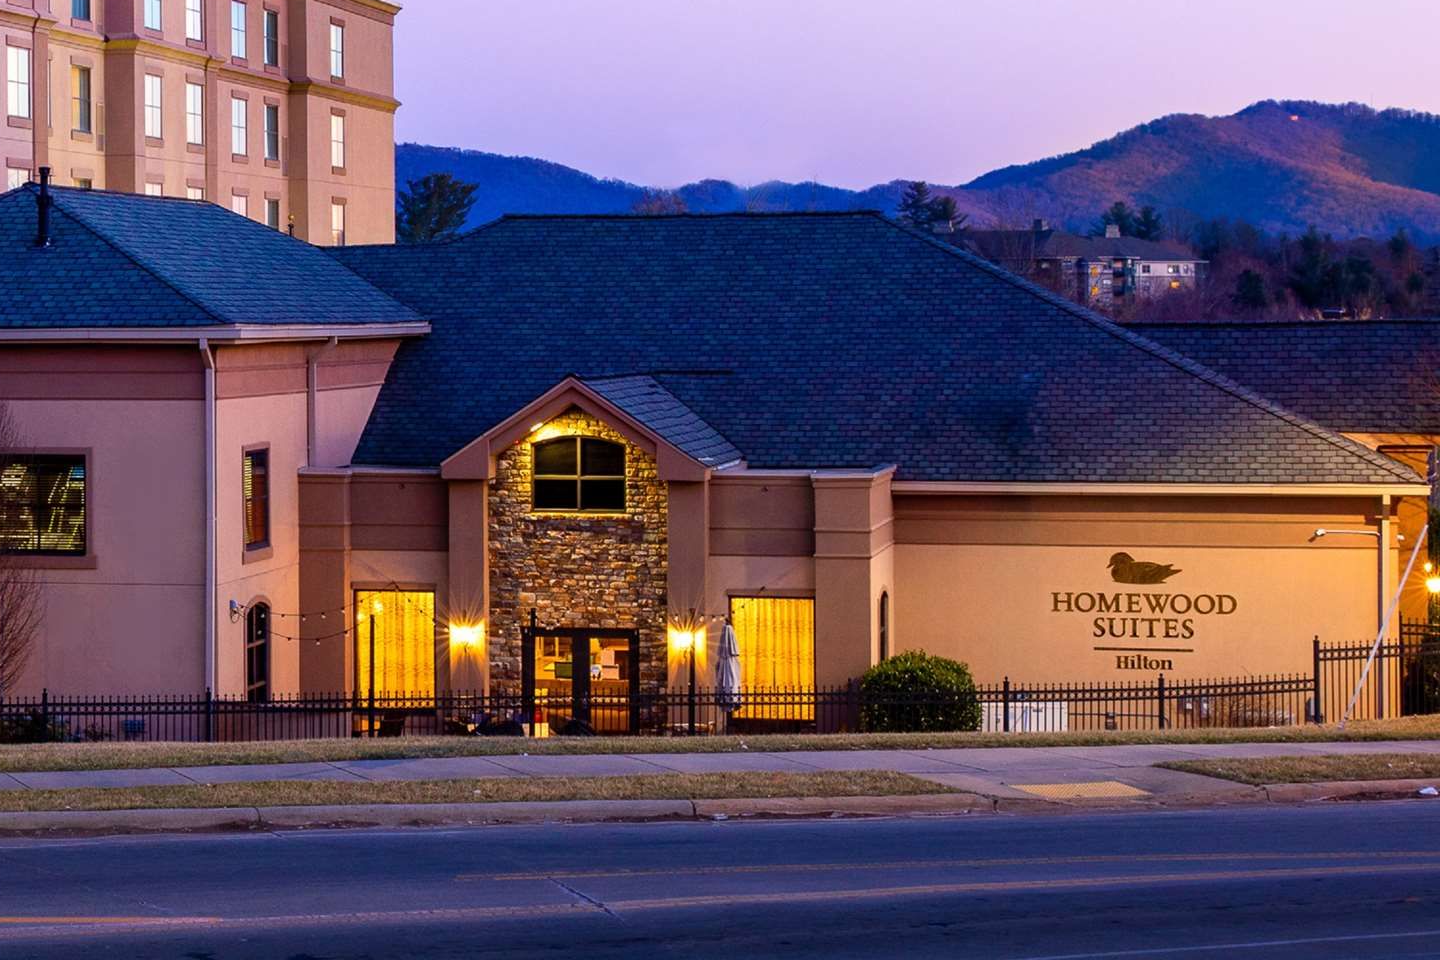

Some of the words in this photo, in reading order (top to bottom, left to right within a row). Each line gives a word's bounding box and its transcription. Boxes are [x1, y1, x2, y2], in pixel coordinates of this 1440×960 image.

[1051, 592, 1238, 615] HOMEWOOD
[1093, 617, 1195, 639] SUITES
[1116, 654, 1173, 671] Hilton
